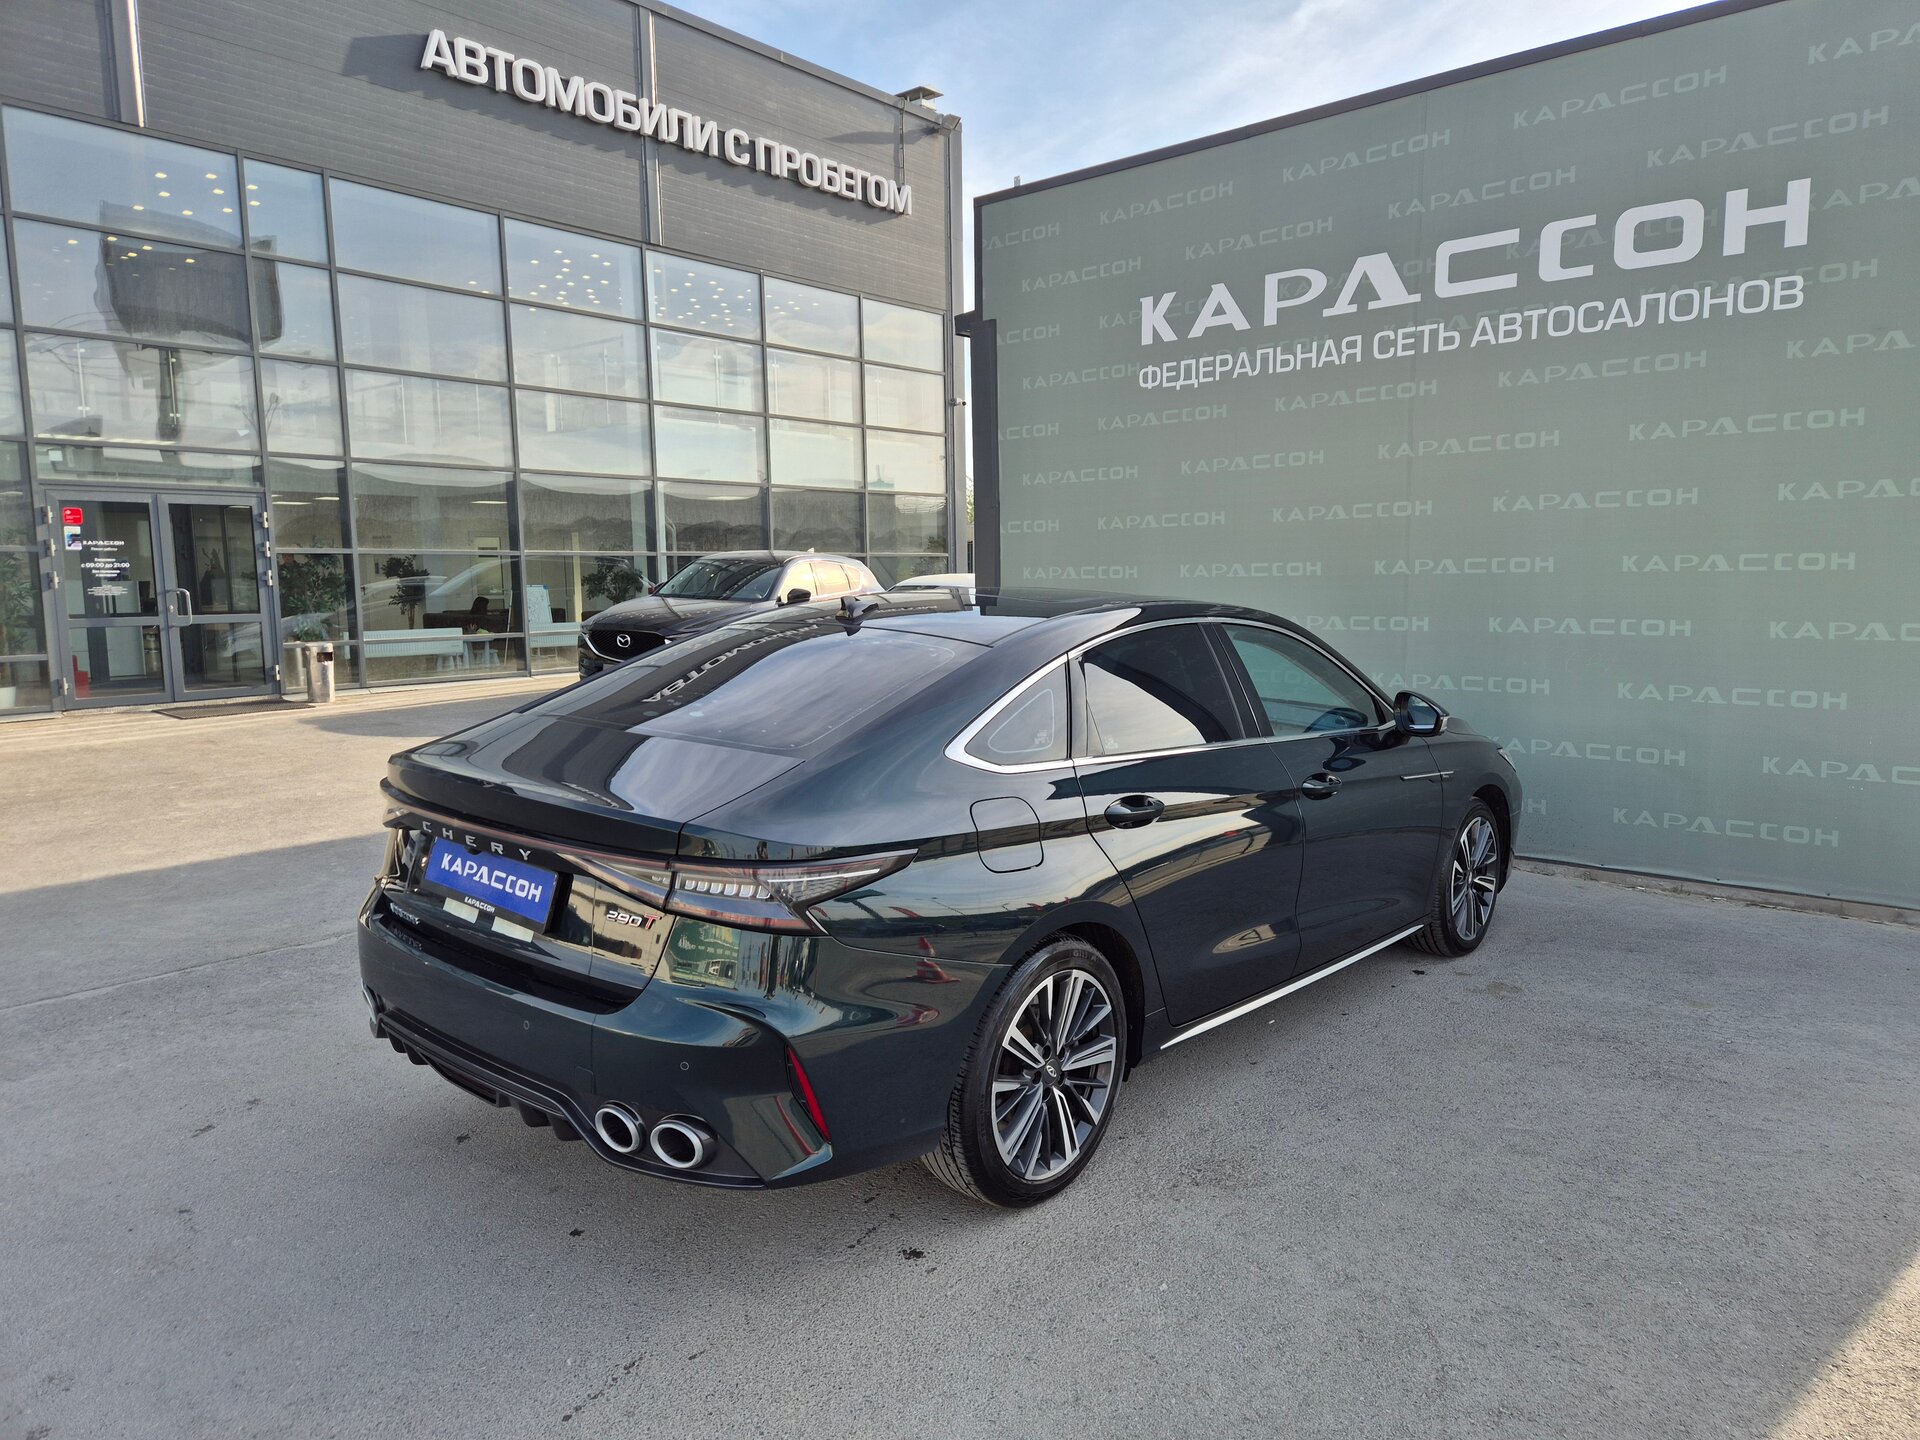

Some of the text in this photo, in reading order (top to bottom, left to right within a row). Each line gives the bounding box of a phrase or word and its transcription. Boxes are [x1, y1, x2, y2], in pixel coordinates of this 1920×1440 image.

[1513, 65, 1727, 130] КАРАССОН
[421, 29, 912, 216] АВТОМОБИЛИ С ПРОБЕГОМ
[1647, 105, 1889, 168] КАРАССОН
[1282, 129, 1450, 183] КАРАССОН
[1100, 181, 1233, 225] КАРАССОН
[1388, 165, 1576, 220] КАРАССОН
[1185, 216, 1333, 261] КАРАССОН
[1022, 256, 1142, 292] КАРАССОН
[1138, 177, 1812, 346] КАРАССОН
[1138, 325, 1364, 390] ФЕДЕРАЛЬНАЯ
[1373, 323, 1461, 360] СЕТЬ
[1470, 274, 1806, 349] АВТОСАЛОНОВ
[1786, 330, 1916, 360] КАРА
[1498, 349, 1707, 389] КАРАССОН
[1274, 379, 1438, 412] КАРАССОН
[1098, 404, 1227, 432] КАРАССОН
[1627, 406, 1866, 442] КАРАССОН
[1377, 430, 1560, 460] КАРАССОН
[1022, 465, 1138, 487] КАРАССОН
[1180, 449, 1325, 476] КАРАССОН
[1272, 500, 1433, 524] КАРАССОН
[1492, 487, 1699, 513] КАРАССОН
[1097, 511, 1226, 532] КАРАССОН
[1022, 565, 1138, 580] КАРАССОН
[1179, 561, 1322, 579] КАРАССОН
[1373, 556, 1555, 575] КАРАССОН
[1621, 551, 1857, 574] КАРАССОН
[1488, 616, 1692, 638] КАРАССОН
[1617, 682, 1848, 711] КАРАССОН
[422, 821, 531, 861] CHERY
[1612, 808, 1840, 848] КАРАССОН
[440, 853, 543, 903] КАРАССОН
[464, 896, 496, 913] КАРАССОН
[606, 910, 661, 930] 290T
